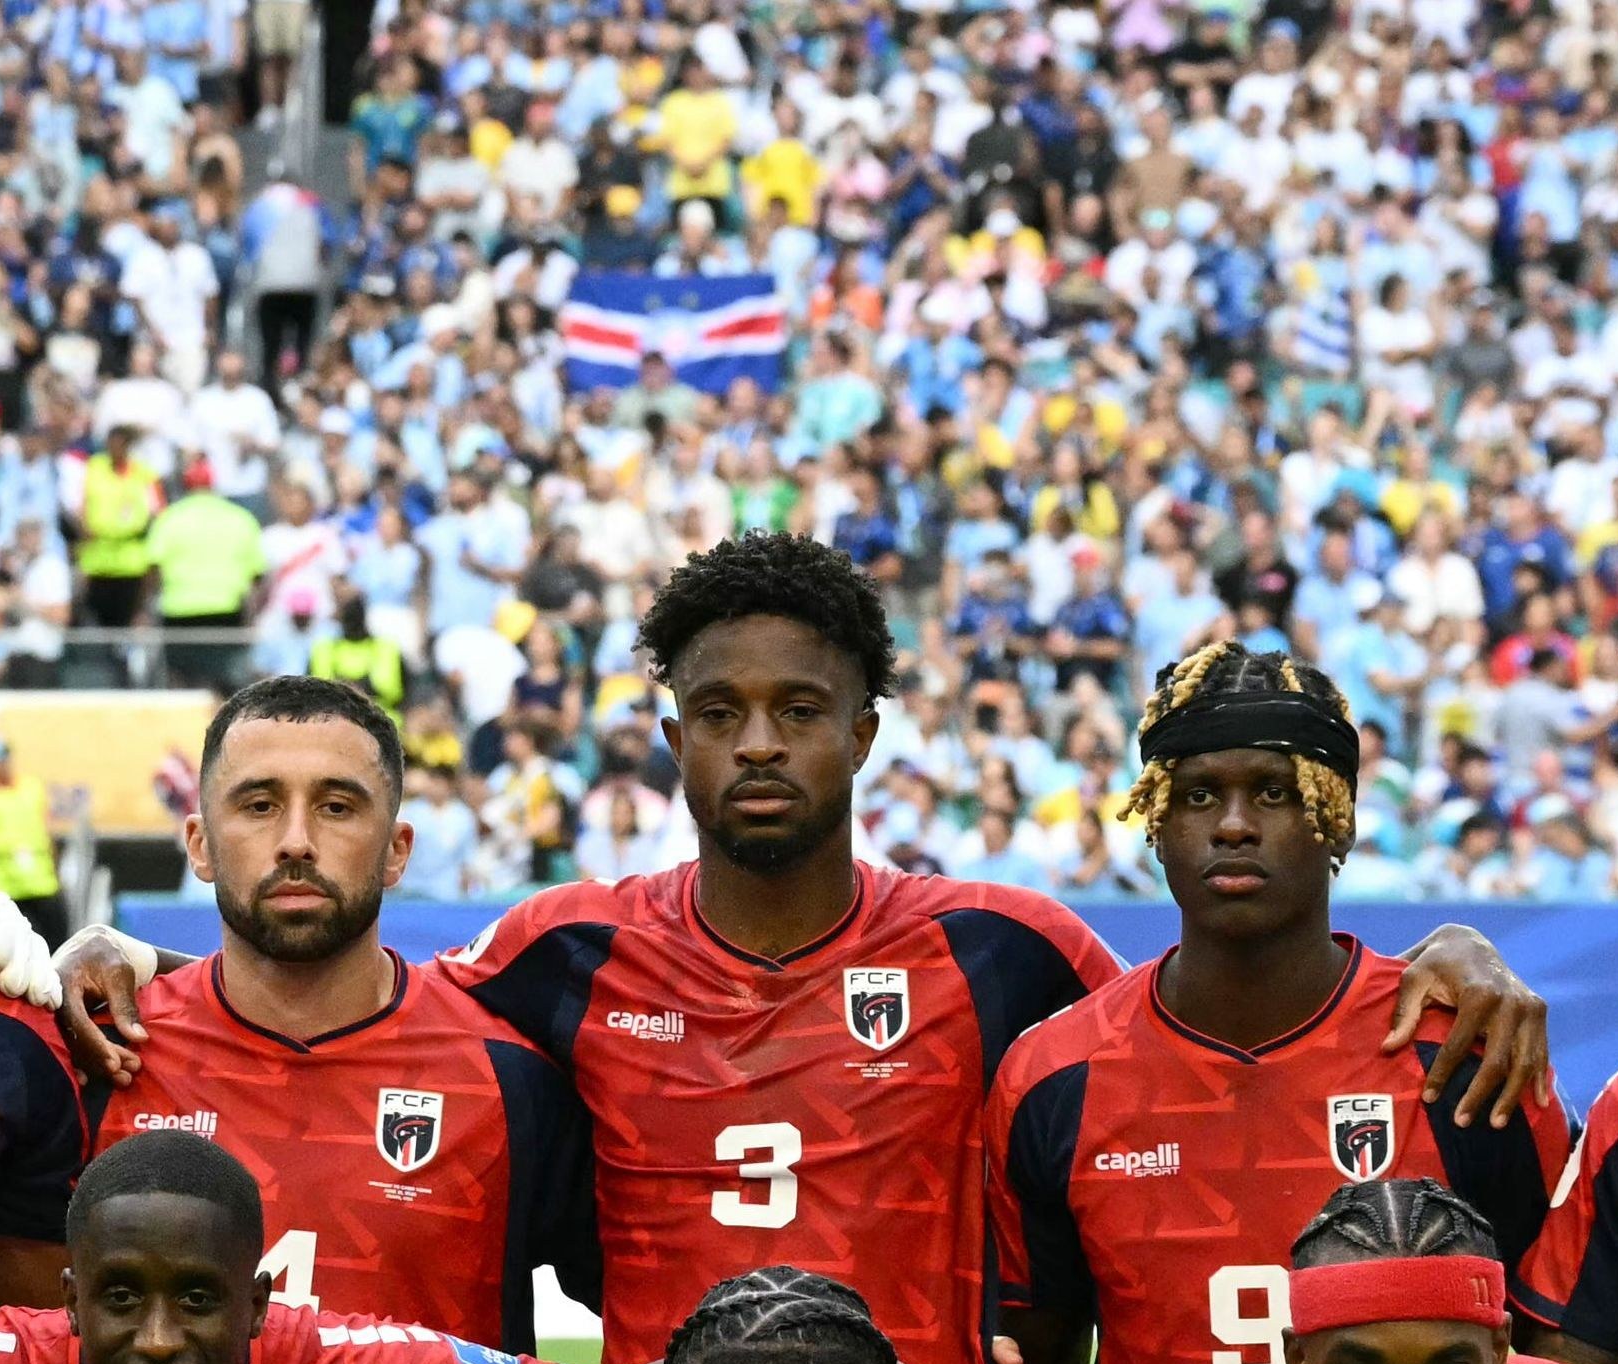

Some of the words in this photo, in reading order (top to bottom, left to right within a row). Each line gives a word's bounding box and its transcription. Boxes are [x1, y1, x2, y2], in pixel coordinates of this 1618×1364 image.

[849, 972, 901, 985] FCF
[606, 1010, 685, 1036] capelli
[637, 1029, 684, 1044] SPORT
[385, 1093, 438, 1108] FCF
[1334, 1099, 1387, 1114] FCF
[1094, 1142, 1180, 1176] capelli
[711, 1121, 803, 1229] 3
[1132, 1166, 1181, 1178] SPORT
[253, 1229, 320, 1316] 4
